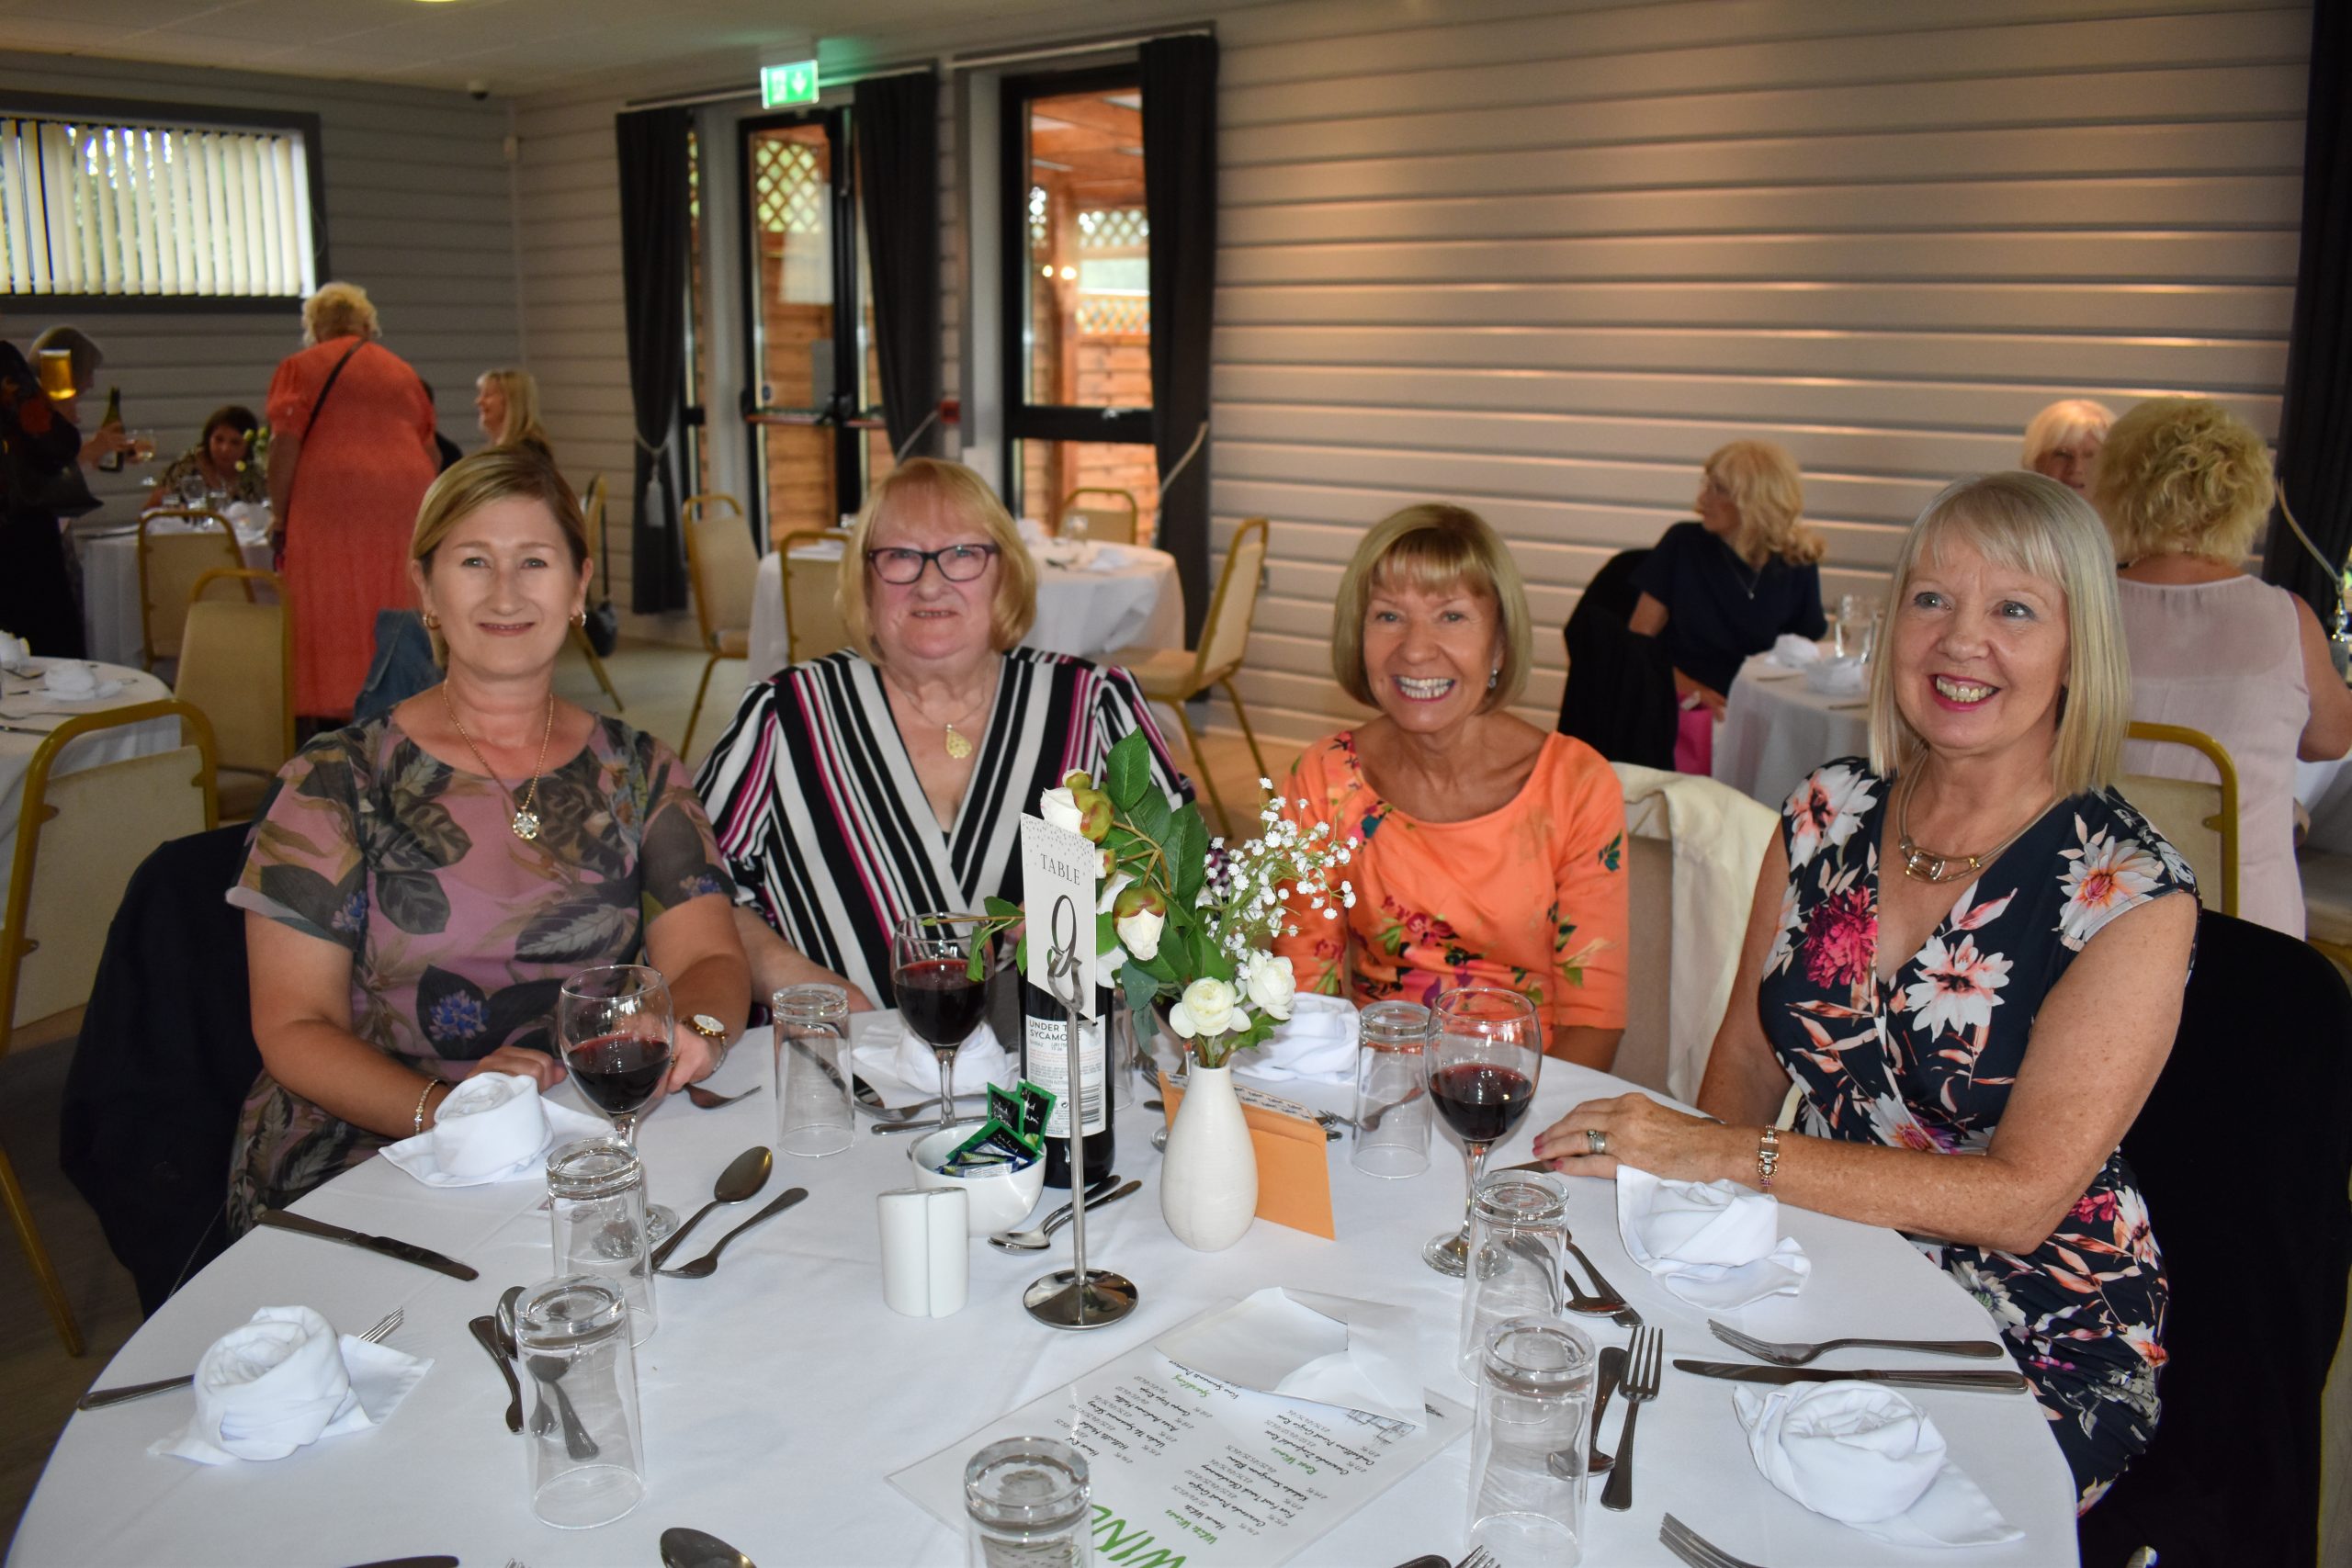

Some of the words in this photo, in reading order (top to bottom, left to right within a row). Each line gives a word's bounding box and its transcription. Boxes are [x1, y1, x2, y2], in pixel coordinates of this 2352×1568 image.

[1040, 852, 1080, 886] TABLE
[1051, 894, 1077, 978] 9
[1029, 1020, 1059, 1032] UNDER
[1062, 1023, 1081, 1032] TE
[1030, 1029, 1080, 1042] SYCAMO
[1170, 1374, 1211, 1398] Sparkling
[1223, 1388, 1239, 1400] Vino
[1087, 1400, 1107, 1415] Shiraz
[1170, 1404, 1191, 1417] Campo
[1105, 1412, 1136, 1431] Sycamore
[1276, 1414, 1293, 1426] Rose
[1079, 1421, 1102, 1436] Merlot
[1134, 1428, 1146, 1438] The
[1264, 1429, 1281, 1441] Rose
[1292, 1422, 1315, 1436] Grigio
[1146, 1434, 1166, 1449] Under
[1312, 1433, 1336, 1447] Pinot
[1080, 1443, 1100, 1457] House
[1270, 1447, 1297, 1465] Wines
[1276, 1438, 1316, 1459] Zinfandel
[1227, 1455, 1248, 1470] Blanc
[1296, 1461, 1318, 1476] Rose
[1315, 1455, 1350, 1475] Crescendo
[1200, 1464, 1243, 1490] Chardonnay
[1248, 1466, 1283, 1488] Sauvignon
[1187, 1481, 1211, 1496] Grigio
[1207, 1494, 1232, 1509] Pinot
[1260, 1497, 1280, 1510] Foot
[1164, 1508, 1193, 1529] Wines
[1184, 1504, 1204, 1518] White
[1230, 1505, 1266, 1528] Crescendo
[1278, 1507, 1296, 1519] Five
[1204, 1516, 1227, 1531] House
[1192, 1525, 1218, 1545] White
